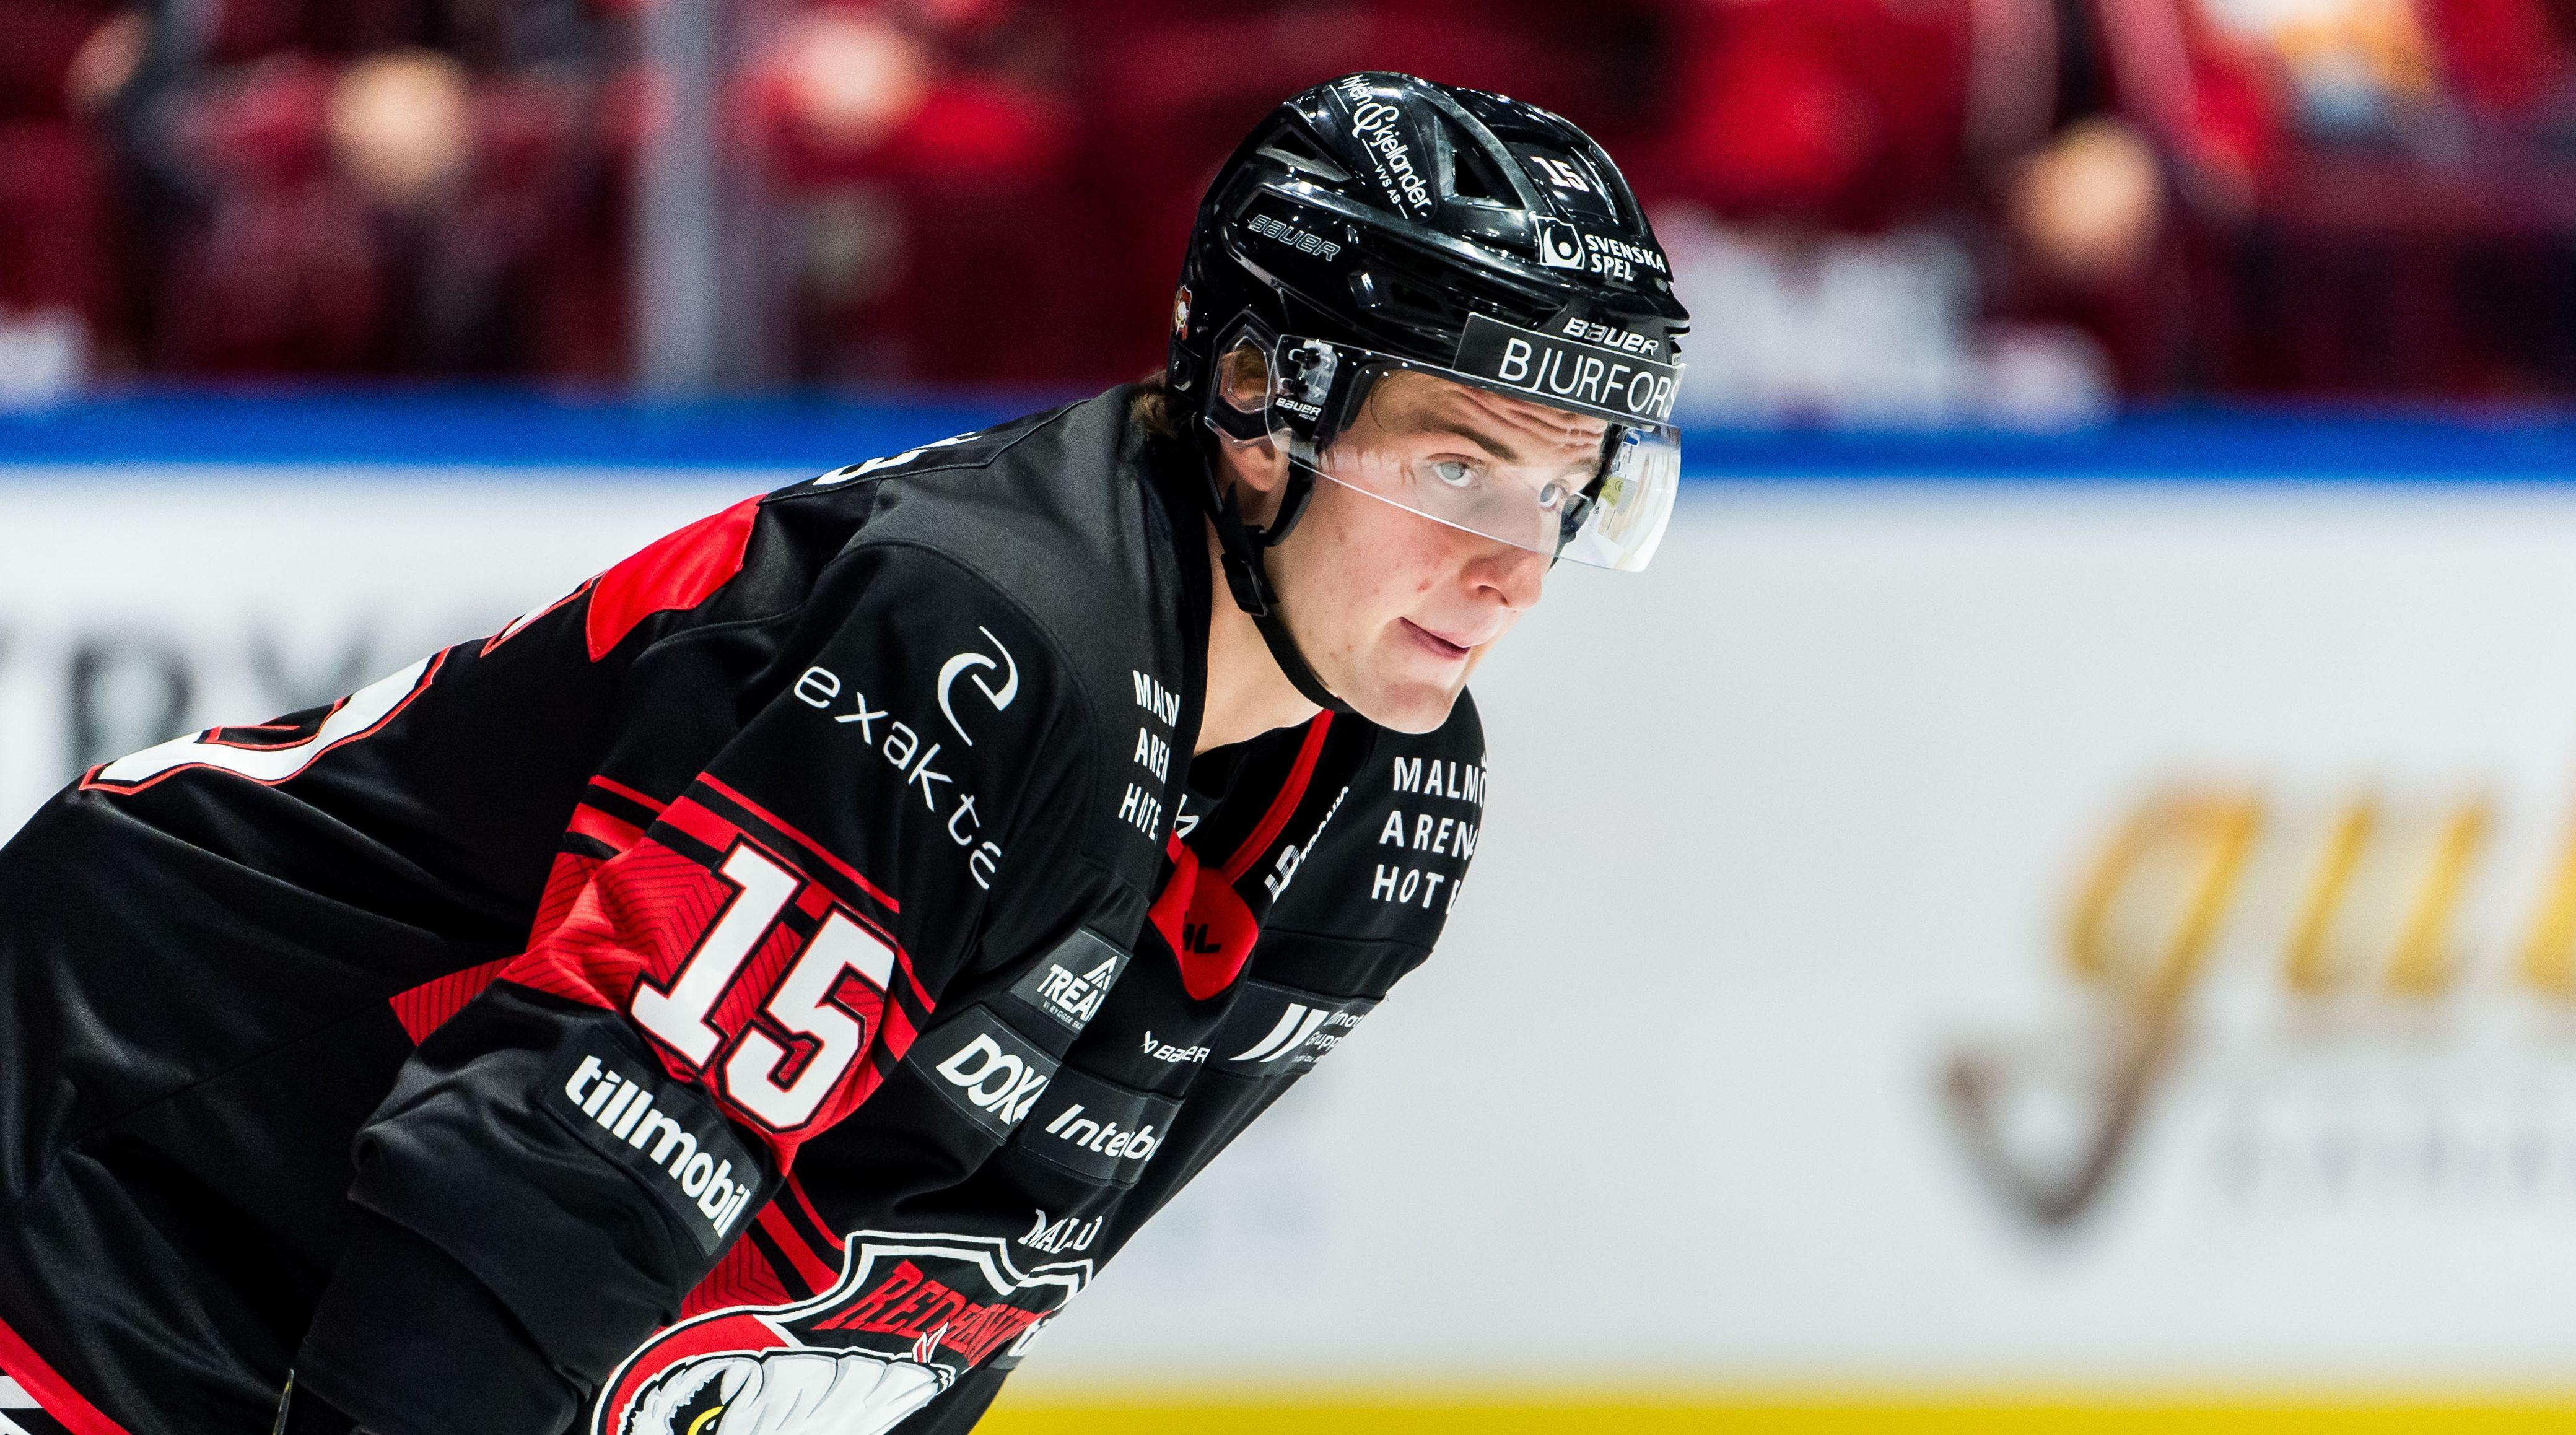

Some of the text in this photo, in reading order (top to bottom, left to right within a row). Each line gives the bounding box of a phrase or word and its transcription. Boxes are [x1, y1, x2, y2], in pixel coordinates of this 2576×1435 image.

[1369, 123, 1432, 209] kjellander
[1374, 164, 1401, 205] VVS AB
[1529, 155, 1591, 193] 15
[1247, 214, 1342, 262] BAUER
[1584, 233, 1667, 274] SVENSKA
[1591, 253, 1634, 282] SPEL
[1562, 316, 1659, 357] BAUER
[1275, 397, 1322, 417] BAUER
[1118, 782, 1161, 844] HOTE
[628, 839, 897, 1132] 15
[1153, 1045, 1211, 1064] BAER
[565, 1055, 751, 1238] tillmobil
